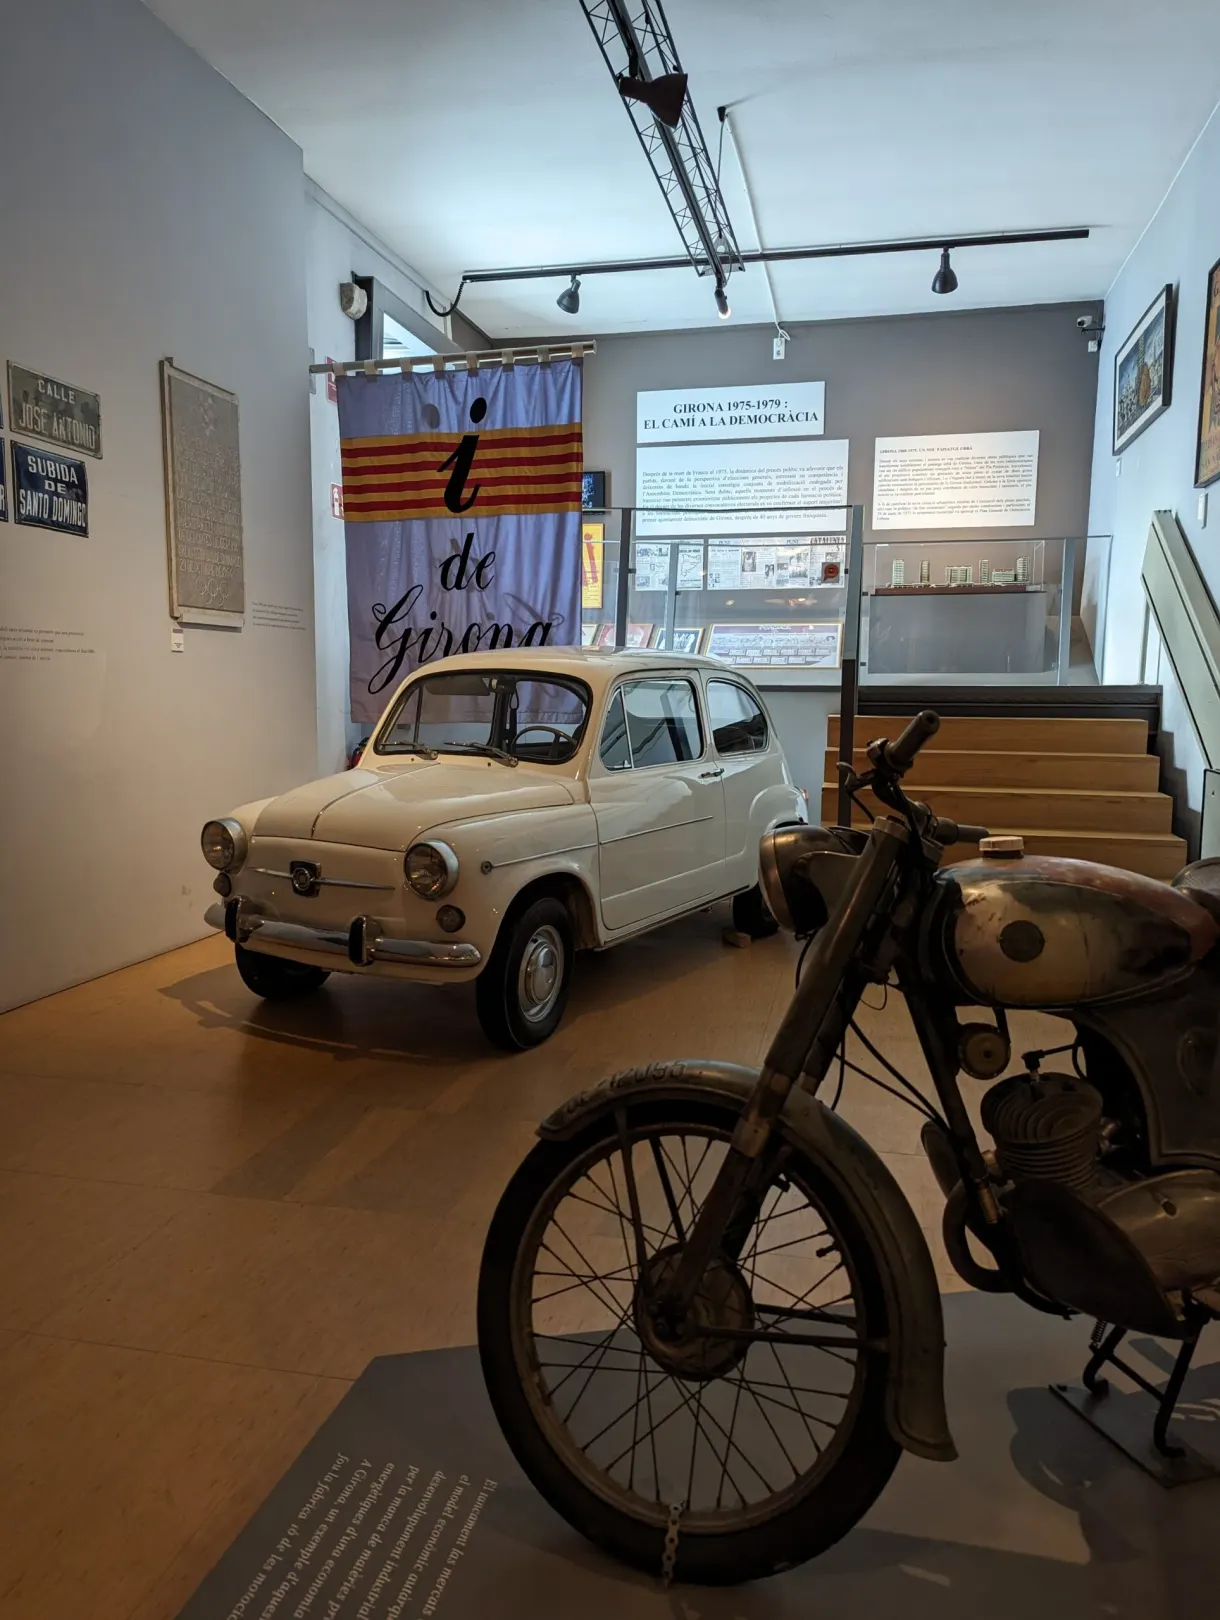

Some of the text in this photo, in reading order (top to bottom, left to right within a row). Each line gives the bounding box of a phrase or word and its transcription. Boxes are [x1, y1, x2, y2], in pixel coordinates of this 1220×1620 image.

[38, 380, 76, 404] CALLE
[673, 403, 723, 414] GIRONA
[727, 399, 781, 412] 1975-1979
[20, 402, 96, 449] JOSE ANTONIO
[644, 410, 819, 430] EL CAMÍ A LA DEMOCRÀCIA
[28, 456, 78, 484] SUBIDA
[44, 480, 66, 494] DE
[20, 489, 49, 519] SANTO
[440, 532, 496, 590] de
[368, 584, 552, 694] Girona
[331, 1452, 350, 1471] fou
[360, 1458, 373, 1468] A
[323, 1472, 339, 1482] la
[405, 1464, 420, 1485] per
[458, 1474, 471, 1486] el
[482, 1478, 498, 1492] El
[397, 1484, 413, 1496] la
[442, 1485, 464, 1519] model
[324, 1508, 340, 1523] un
[376, 1496, 403, 1532] manca
[276, 1537, 292, 1552] de
[293, 1462, 395, 1619] energètiques d'una economia
[294, 1524, 329, 1570] exemple
[356, 1470, 447, 1620] desenvolupament industrial
[367, 1532, 383, 1548] de
[413, 1518, 447, 1572] econòmic
[262, 1554, 283, 1571] les
[336, 1549, 372, 1601] matèries
[422, 1567, 452, 1616] mercats
